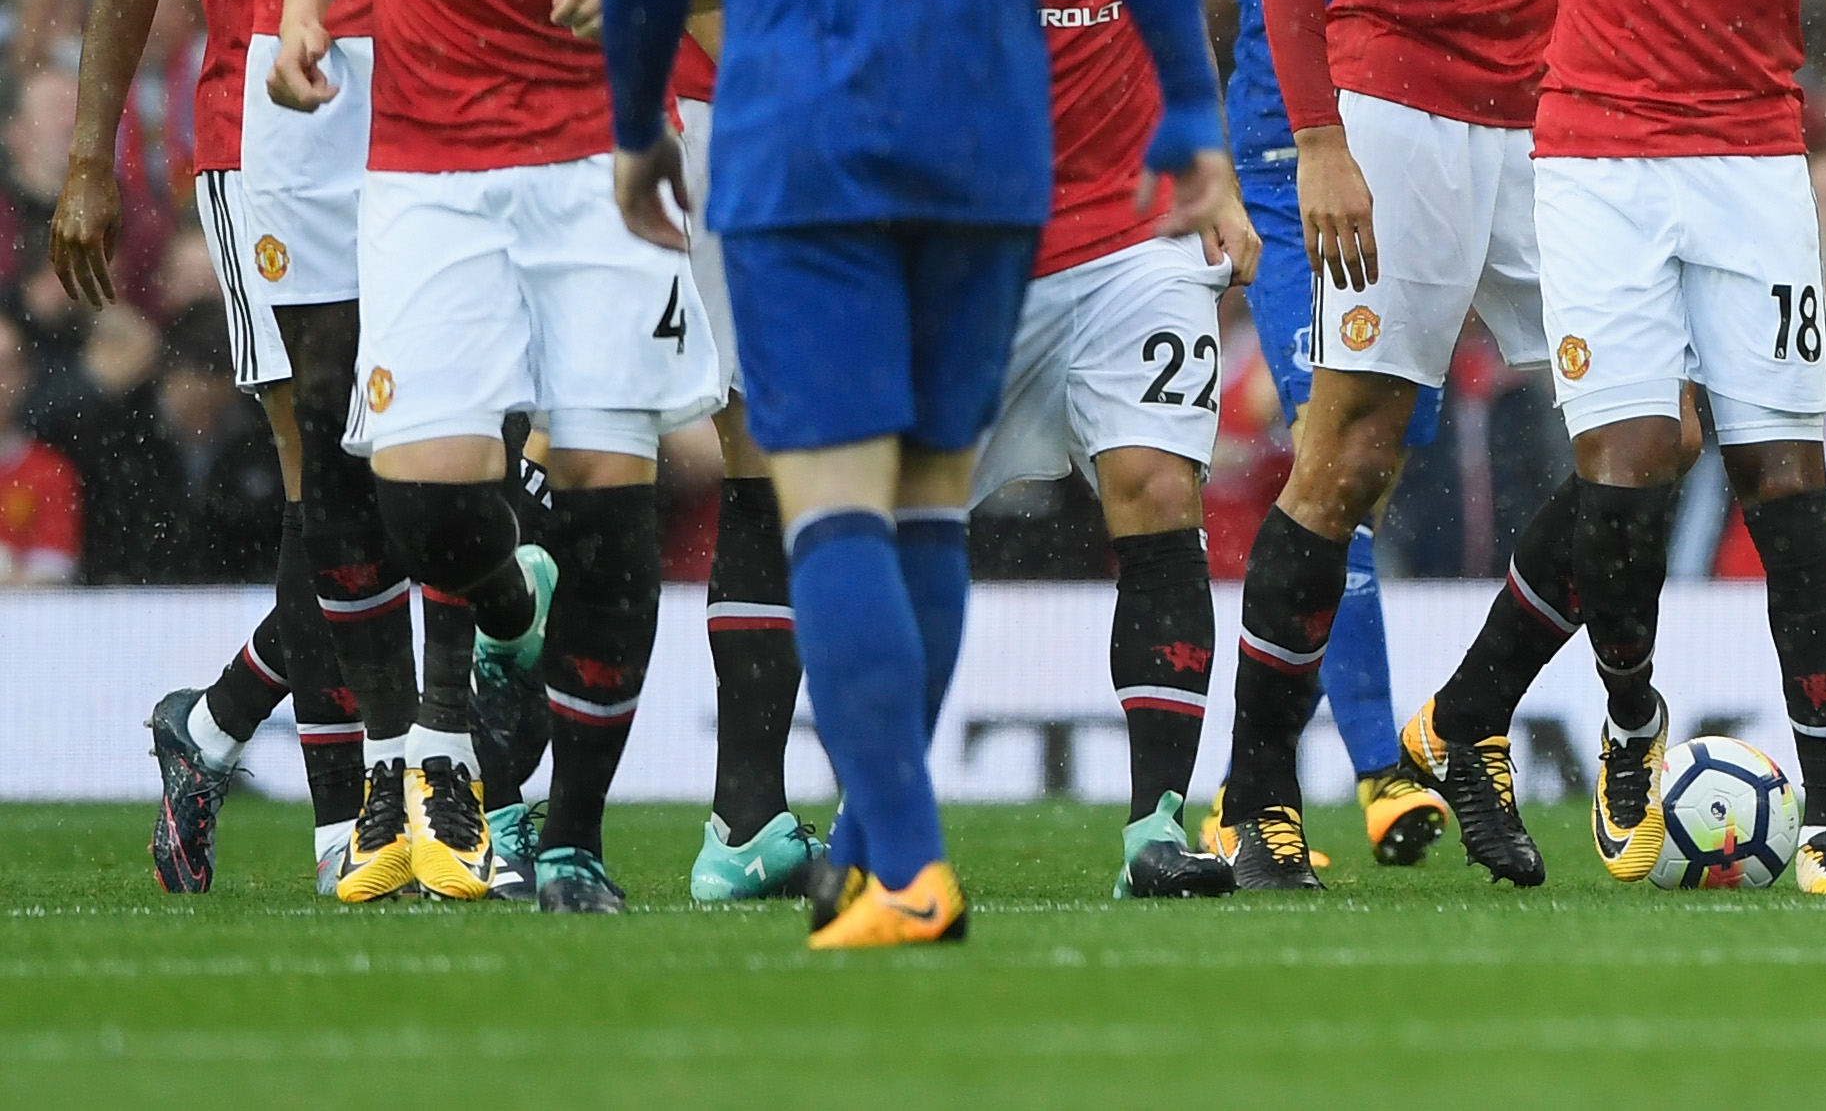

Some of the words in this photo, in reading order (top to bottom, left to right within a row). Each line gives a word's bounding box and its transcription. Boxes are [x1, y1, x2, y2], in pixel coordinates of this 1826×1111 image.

[1038, 0, 1123, 27] ROLET
[652, 275, 687, 355] 4
[1771, 284, 1821, 362] 18
[1140, 331, 1218, 414] 22
